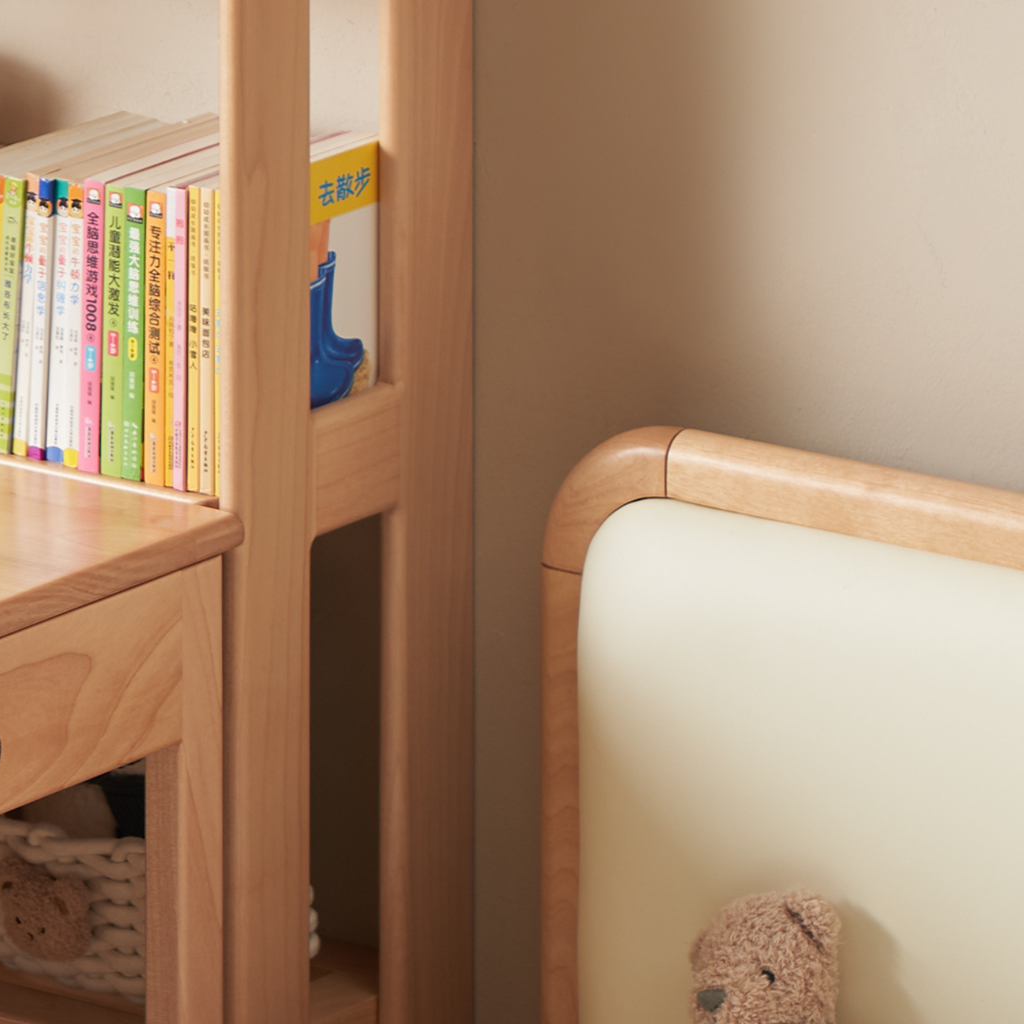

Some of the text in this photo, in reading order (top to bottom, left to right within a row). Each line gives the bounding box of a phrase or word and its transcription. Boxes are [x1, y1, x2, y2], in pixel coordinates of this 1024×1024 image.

[318, 167, 371, 206] 去散步
[108, 216, 121, 316] 儿童潜能大激发
[127, 227, 140, 334] 最强大脑思维训练
[149, 226, 162, 354] 专注力全脑综合测试
[2, 280, 12, 340] 雅各布长大了
[202, 307, 210, 358] 美味面包店
